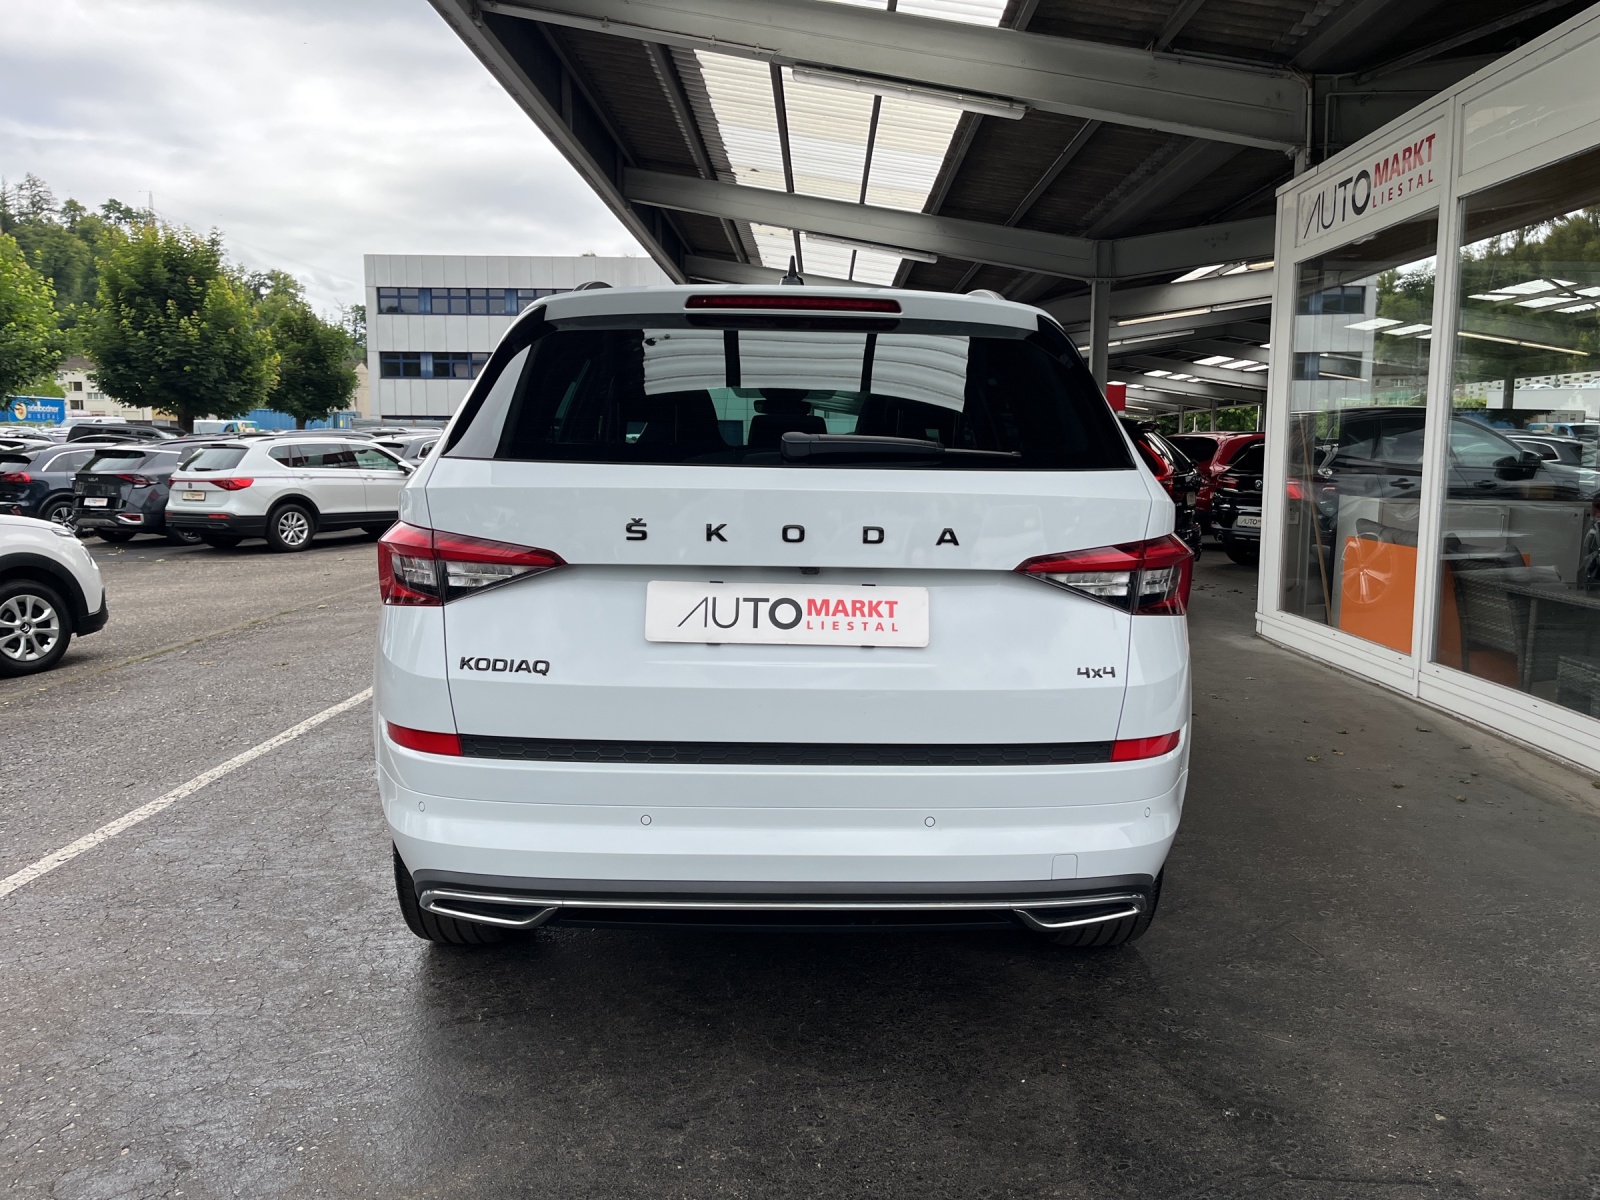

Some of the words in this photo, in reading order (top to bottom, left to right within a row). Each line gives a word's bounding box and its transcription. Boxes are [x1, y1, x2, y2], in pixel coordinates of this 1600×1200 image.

[1304, 169, 1371, 239] AUTO
[1373, 133, 1436, 189] MARKT
[1372, 169, 1433, 208] LIESTAL
[625, 517, 960, 546] ŠKODA
[677, 596, 803, 630] AUTO
[806, 598, 899, 619] MARKT
[806, 620, 899, 632] LIESTAL
[459, 656, 550, 676] KODIAQ
[1076, 666, 1116, 679] 4x4
